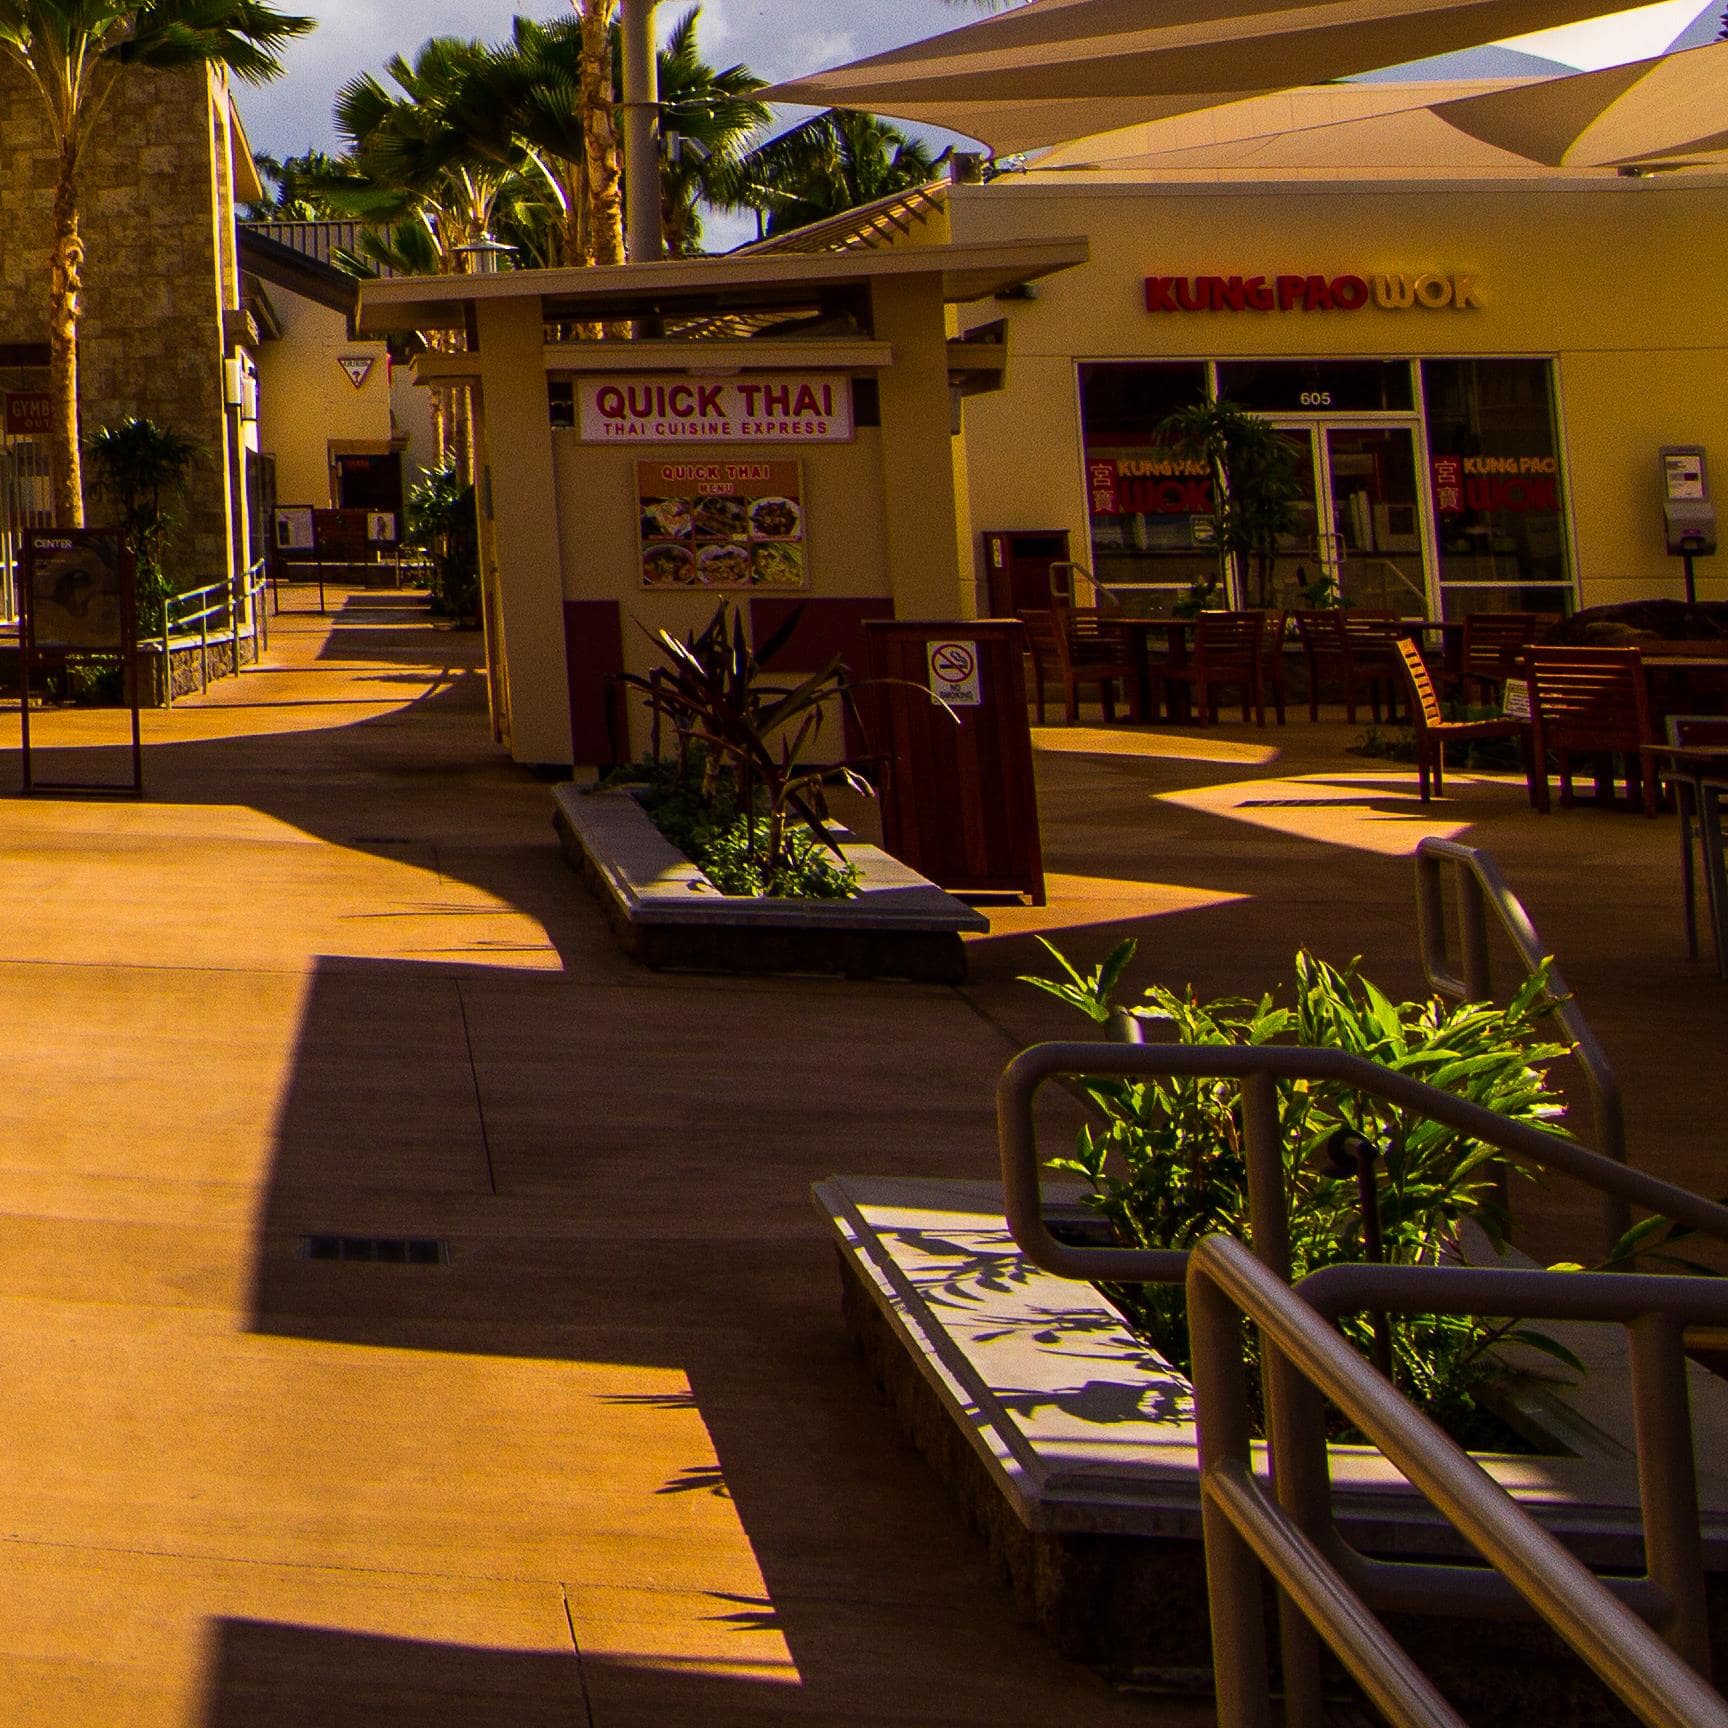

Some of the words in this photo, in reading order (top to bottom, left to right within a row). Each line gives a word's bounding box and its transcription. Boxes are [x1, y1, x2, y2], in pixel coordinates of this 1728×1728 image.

[1145, 274, 1275, 312] KUNG
[1276, 274, 1368, 312] PAO
[1374, 272, 1481, 310] WOK
[596, 385, 727, 420] QUICK
[737, 384, 832, 417] THAI
[1300, 392, 1331, 405] 605
[604, 422, 645, 435] THAI
[655, 422, 732, 435] CUISINE
[741, 421, 827, 435] EXPRESS
[662, 465, 721, 481] QUICK
[726, 465, 770, 480] THAI
[1118, 459, 1172, 477] KUNG
[1463, 457, 1519, 475] KUNG
[1519, 457, 1555, 474] PAO
[698, 483, 736, 495] MENU
[1120, 480, 1213, 514] WOK
[1466, 478, 1557, 513] WOK
[34, 538, 73, 550] CENTER
